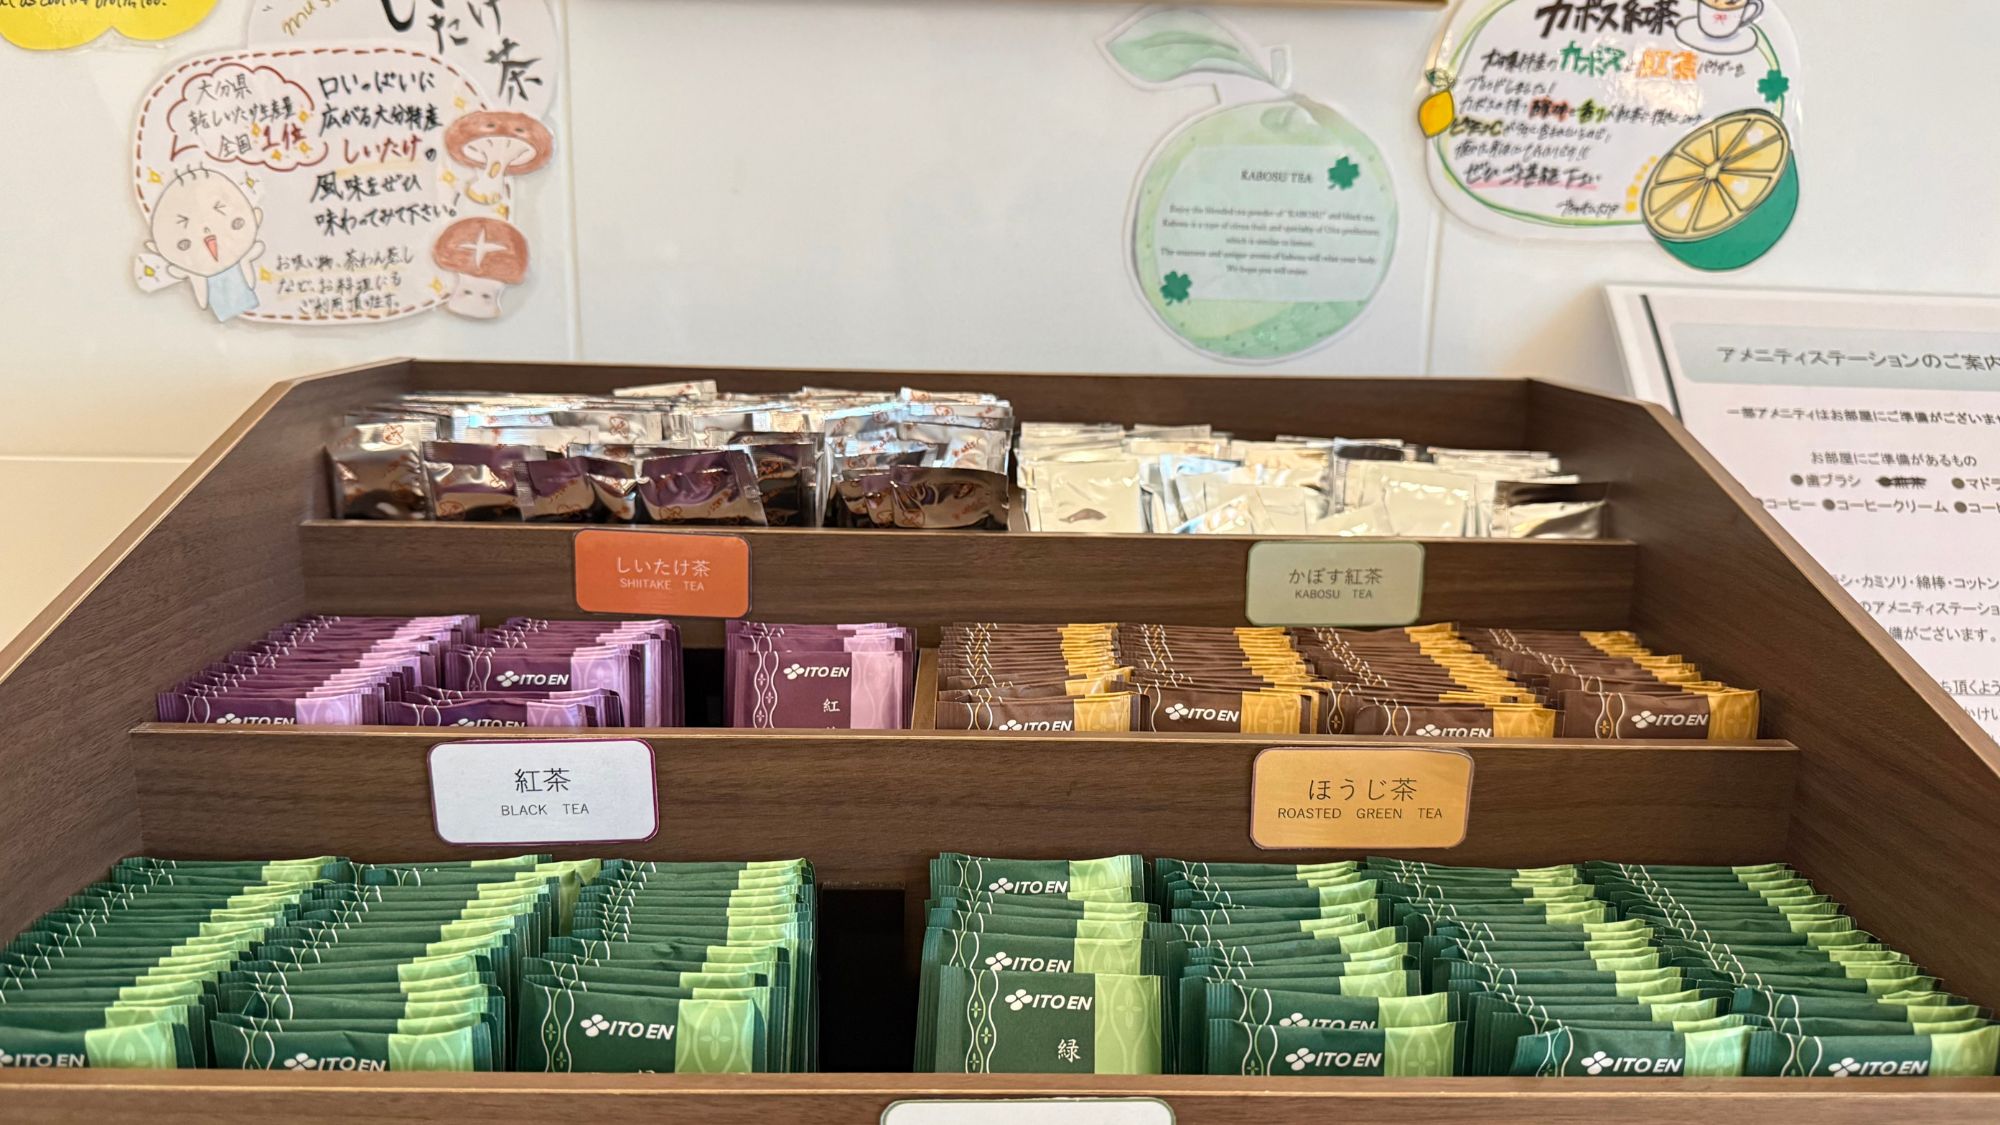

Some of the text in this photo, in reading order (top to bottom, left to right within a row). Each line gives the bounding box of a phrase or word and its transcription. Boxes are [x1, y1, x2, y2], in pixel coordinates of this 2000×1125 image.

[1534, 0, 1681, 38] カボス紅茶
[197, 73, 253, 105] 大分県
[318, 71, 435, 100] 口いっぱいに
[318, 103, 444, 138] 広がる大分特産
[344, 133, 438, 165] しいたけの
[1241, 169, 1313, 184] KABOSU TEA
[309, 170, 423, 204] 風味をぜひ
[1811, 451, 1978, 468] お部屋にご準備があるもの
[616, 556, 712, 578] しいたけ茶
[619, 578, 705, 592] SHIITAKE TEA
[1288, 567, 1384, 586] かぼす紅茶
[1294, 588, 1374, 599] KABOSU TEA
[519, 673, 570, 686] ITO EN
[804, 666, 850, 678] ITO EN
[823, 698, 840, 713] 紅
[1188, 707, 1240, 722] ITO EN
[1656, 714, 1709, 726] ITO EN
[1023, 720, 1072, 731] ITO EN
[1441, 727, 1492, 738] ITO EN
[514, 767, 572, 794] 紅茶
[1309, 777, 1417, 802] ほうじ茶
[501, 803, 590, 817] BLACK TEA
[1277, 807, 1443, 819] ROASTED GREEN TEA
[1013, 880, 1069, 894] ITO EN
[1012, 956, 1072, 973] ITO EN
[1031, 993, 1093, 1011] ITO EN
[609, 1020, 675, 1041] ITO EN
[1057, 1038, 1081, 1063] 緑
[15, 1053, 85, 1068] ITO EN
[317, 1056, 387, 1072] ITO EN
[1314, 1051, 1383, 1068] ITO EN
[1612, 1057, 1684, 1074] ITO EN
[1859, 1060, 1929, 1076] ITO EN
